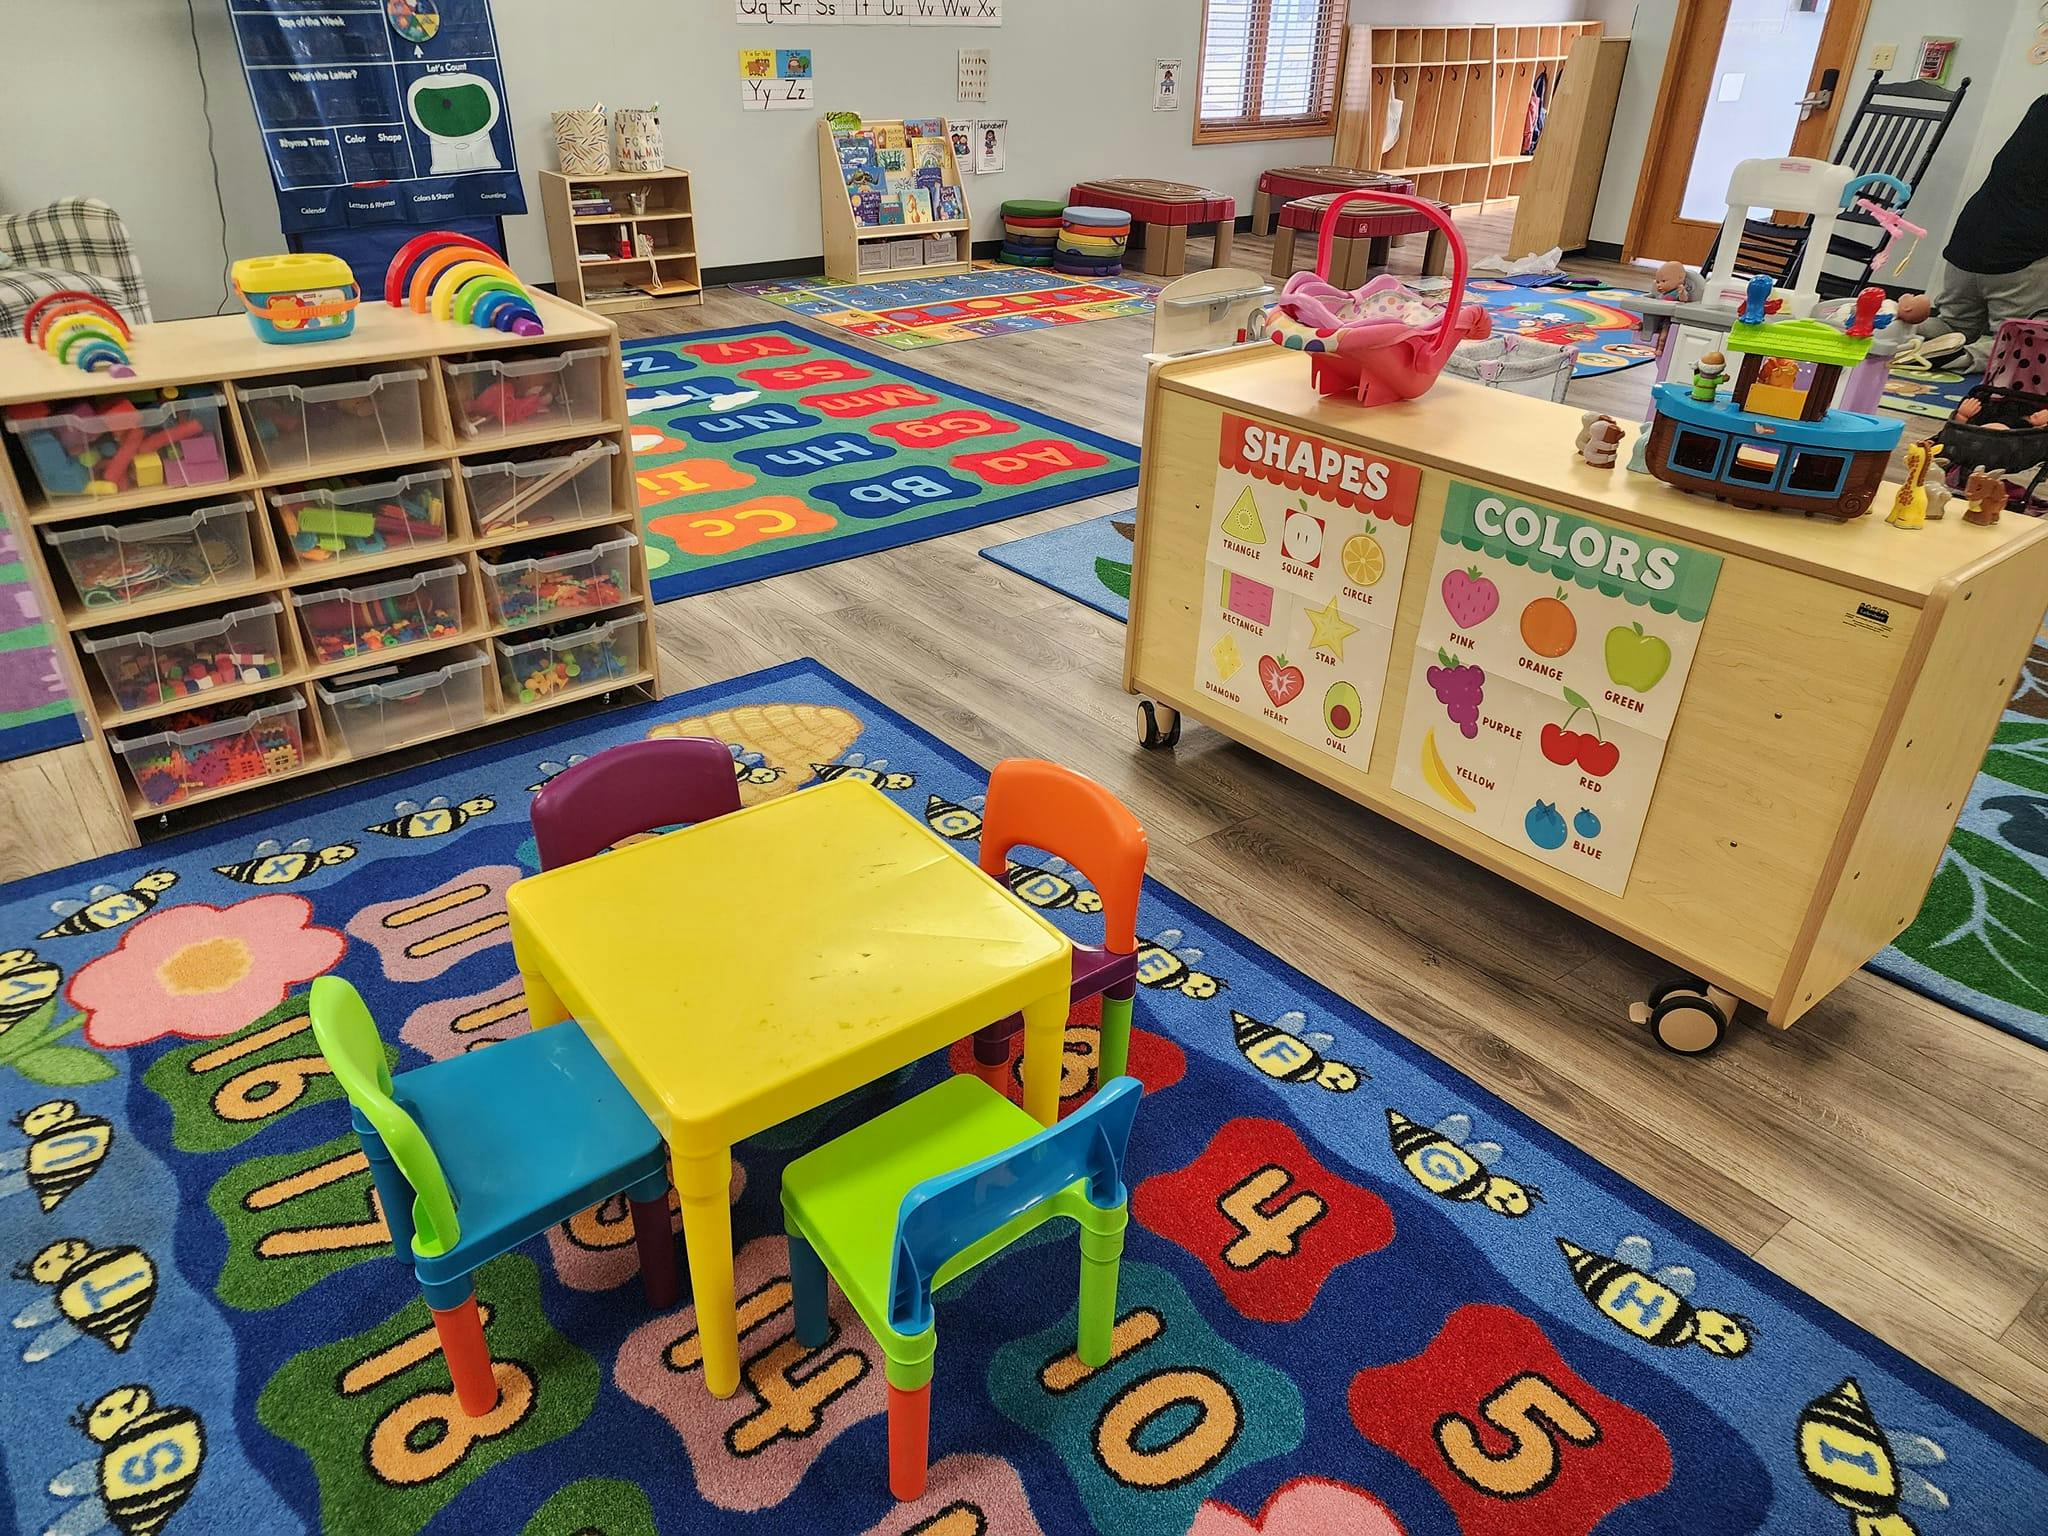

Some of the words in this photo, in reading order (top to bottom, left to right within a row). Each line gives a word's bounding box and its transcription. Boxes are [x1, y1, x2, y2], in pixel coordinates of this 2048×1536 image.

[426, 64, 444, 73] Let's
[445, 63, 467, 71] Count
[1159, 62, 1179, 70] Sensory
[748, 79, 772, 109] Yy
[785, 79, 806, 100] Zz
[980, 122, 1004, 130] Alphabet
[308, 137, 330, 147] Time
[344, 134, 367, 144] Color
[377, 133, 402, 143] Shape
[349, 201, 370, 209] Letters
[413, 194, 432, 202] Colors
[481, 192, 507, 200] Counting
[717, 343, 788, 356] Yy
[772, 365, 844, 381] Ss
[817, 388, 931, 410] Mm
[698, 410, 799, 432] Nn
[896, 417, 993, 439] Gg
[765, 439, 873, 466] Hh
[982, 446, 1074, 473] Aa
[1242, 426, 1391, 501] SHAPES
[849, 474, 953, 504] Bb
[687, 509, 798, 538] Cc
[1222, 539, 1261, 560] TRIANGLE
[1472, 497, 1680, 591] COLORS
[1281, 562, 1314, 581] SQUARE
[1342, 586, 1374, 605] CIRCLE
[1222, 612, 1264, 637] RECTANGLE
[1449, 633, 1475, 650] PINK
[1315, 651, 1337, 667] STAR
[1518, 656, 1564, 682] ORANGE
[1205, 681, 1241, 703] DIAMOND
[1603, 690, 1645, 713] GREEN
[1263, 707, 1289, 726] HEART
[1482, 716, 1523, 741] PURPLE
[1325, 737, 1347, 754] OVAL
[1455, 765, 1496, 791] YELLOW
[1579, 776, 1603, 793] RED
[415, 813, 442, 832] Y
[943, 816, 970, 830] C
[1572, 840, 1603, 860] BLUE
[263, 856, 299, 878] X
[1031, 879, 1061, 899] D
[93, 898, 140, 921] W
[1138, 951, 1169, 977] E
[3, 980, 46, 1000] V
[1259, 1041, 1301, 1067] F
[190, 1015, 336, 1122] 16
[42, 1133, 99, 1168] U
[1419, 1146, 1465, 1182] G
[1216, 1162, 1328, 1273] 4
[80, 1268, 145, 1312] T
[1610, 1282, 1667, 1326] H
[662, 1276, 872, 1459] 14
[337, 1302, 537, 1488] 18
[1037, 1308, 1245, 1492] 10
[1432, 1370, 1605, 1502] 5
[120, 1438, 184, 1485] S
[1817, 1437, 1879, 1477] I
